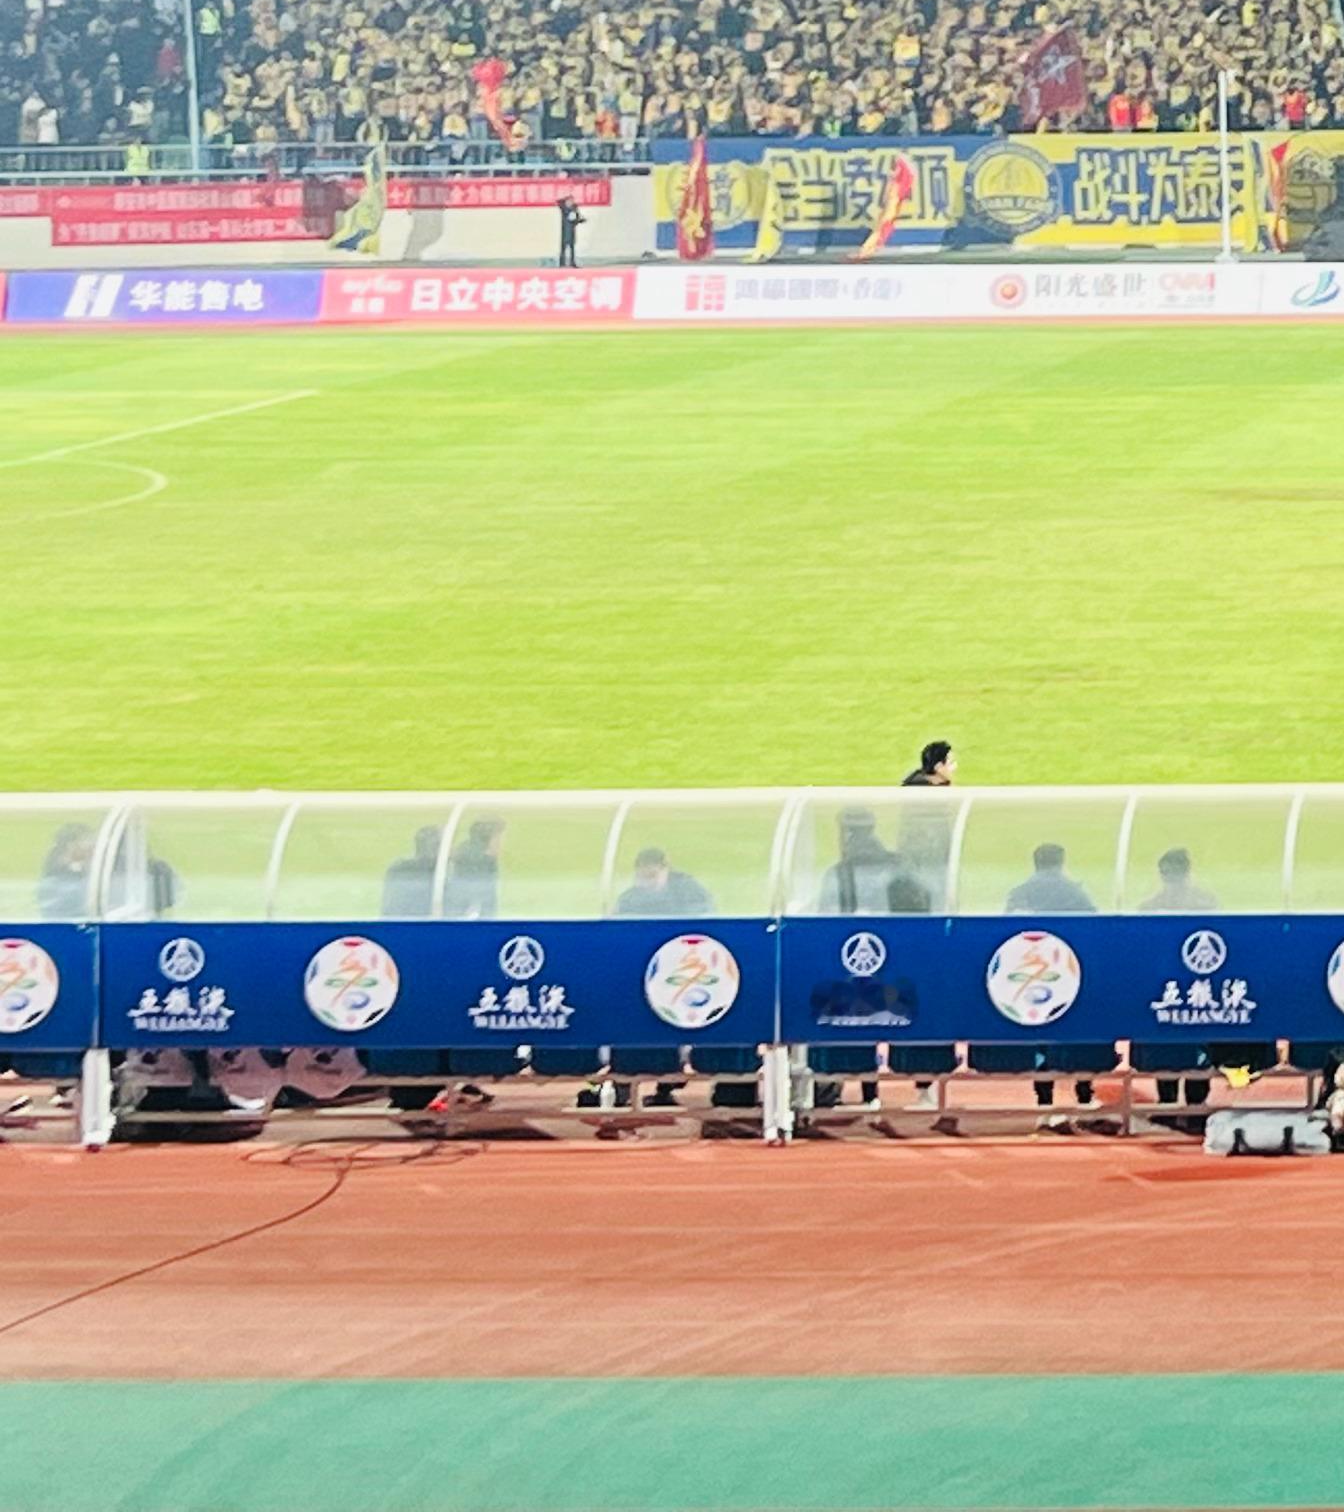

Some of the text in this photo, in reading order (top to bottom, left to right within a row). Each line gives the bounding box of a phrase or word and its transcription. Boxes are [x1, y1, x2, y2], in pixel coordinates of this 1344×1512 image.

[129, 278, 264, 312] 华能售电
[410, 276, 623, 311] 日立中央空调
[126, 986, 235, 1017] 五粮液
[467, 984, 575, 1017] 五粮液
[1149, 977, 1257, 1009] 五粮液
